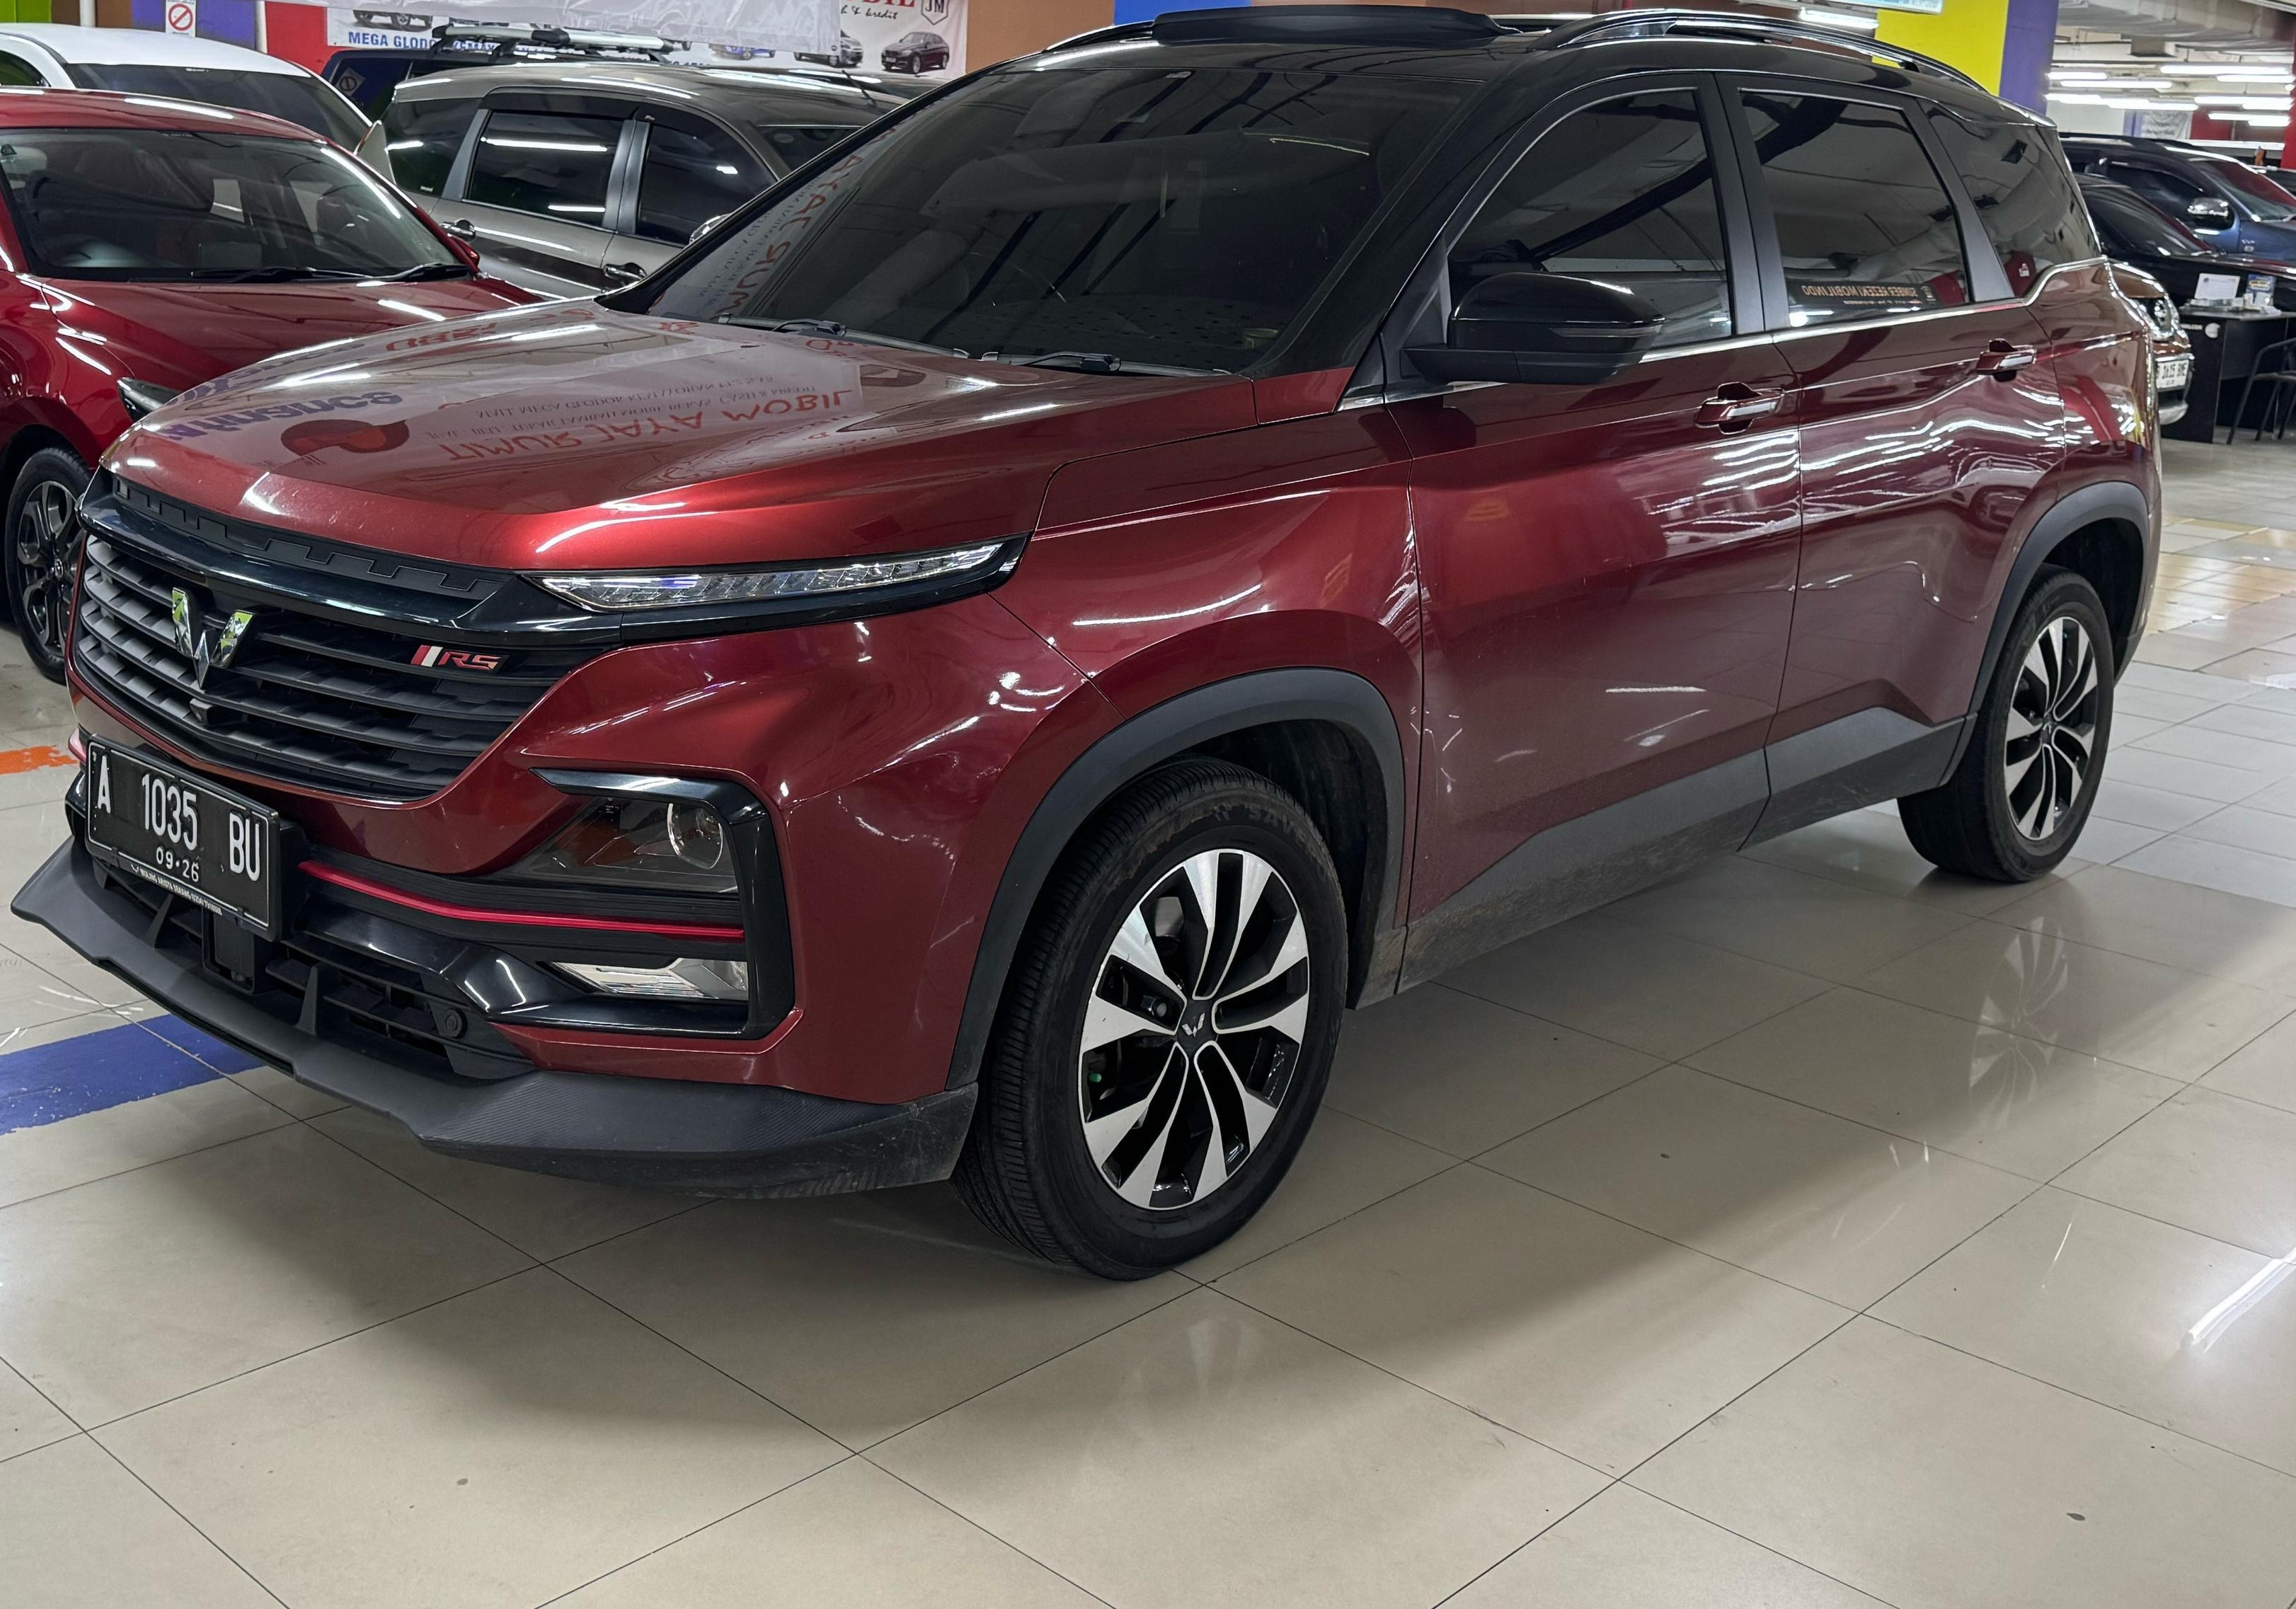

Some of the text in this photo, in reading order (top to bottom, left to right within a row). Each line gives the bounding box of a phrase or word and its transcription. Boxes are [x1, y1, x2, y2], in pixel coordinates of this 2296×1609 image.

[865, 8, 898, 20] kredit
[348, 31, 388, 47] MEGA
[394, 35, 437, 50] GLODO
[437, 650, 501, 671] RS
[97, 755, 260, 882] A 1035 BU
